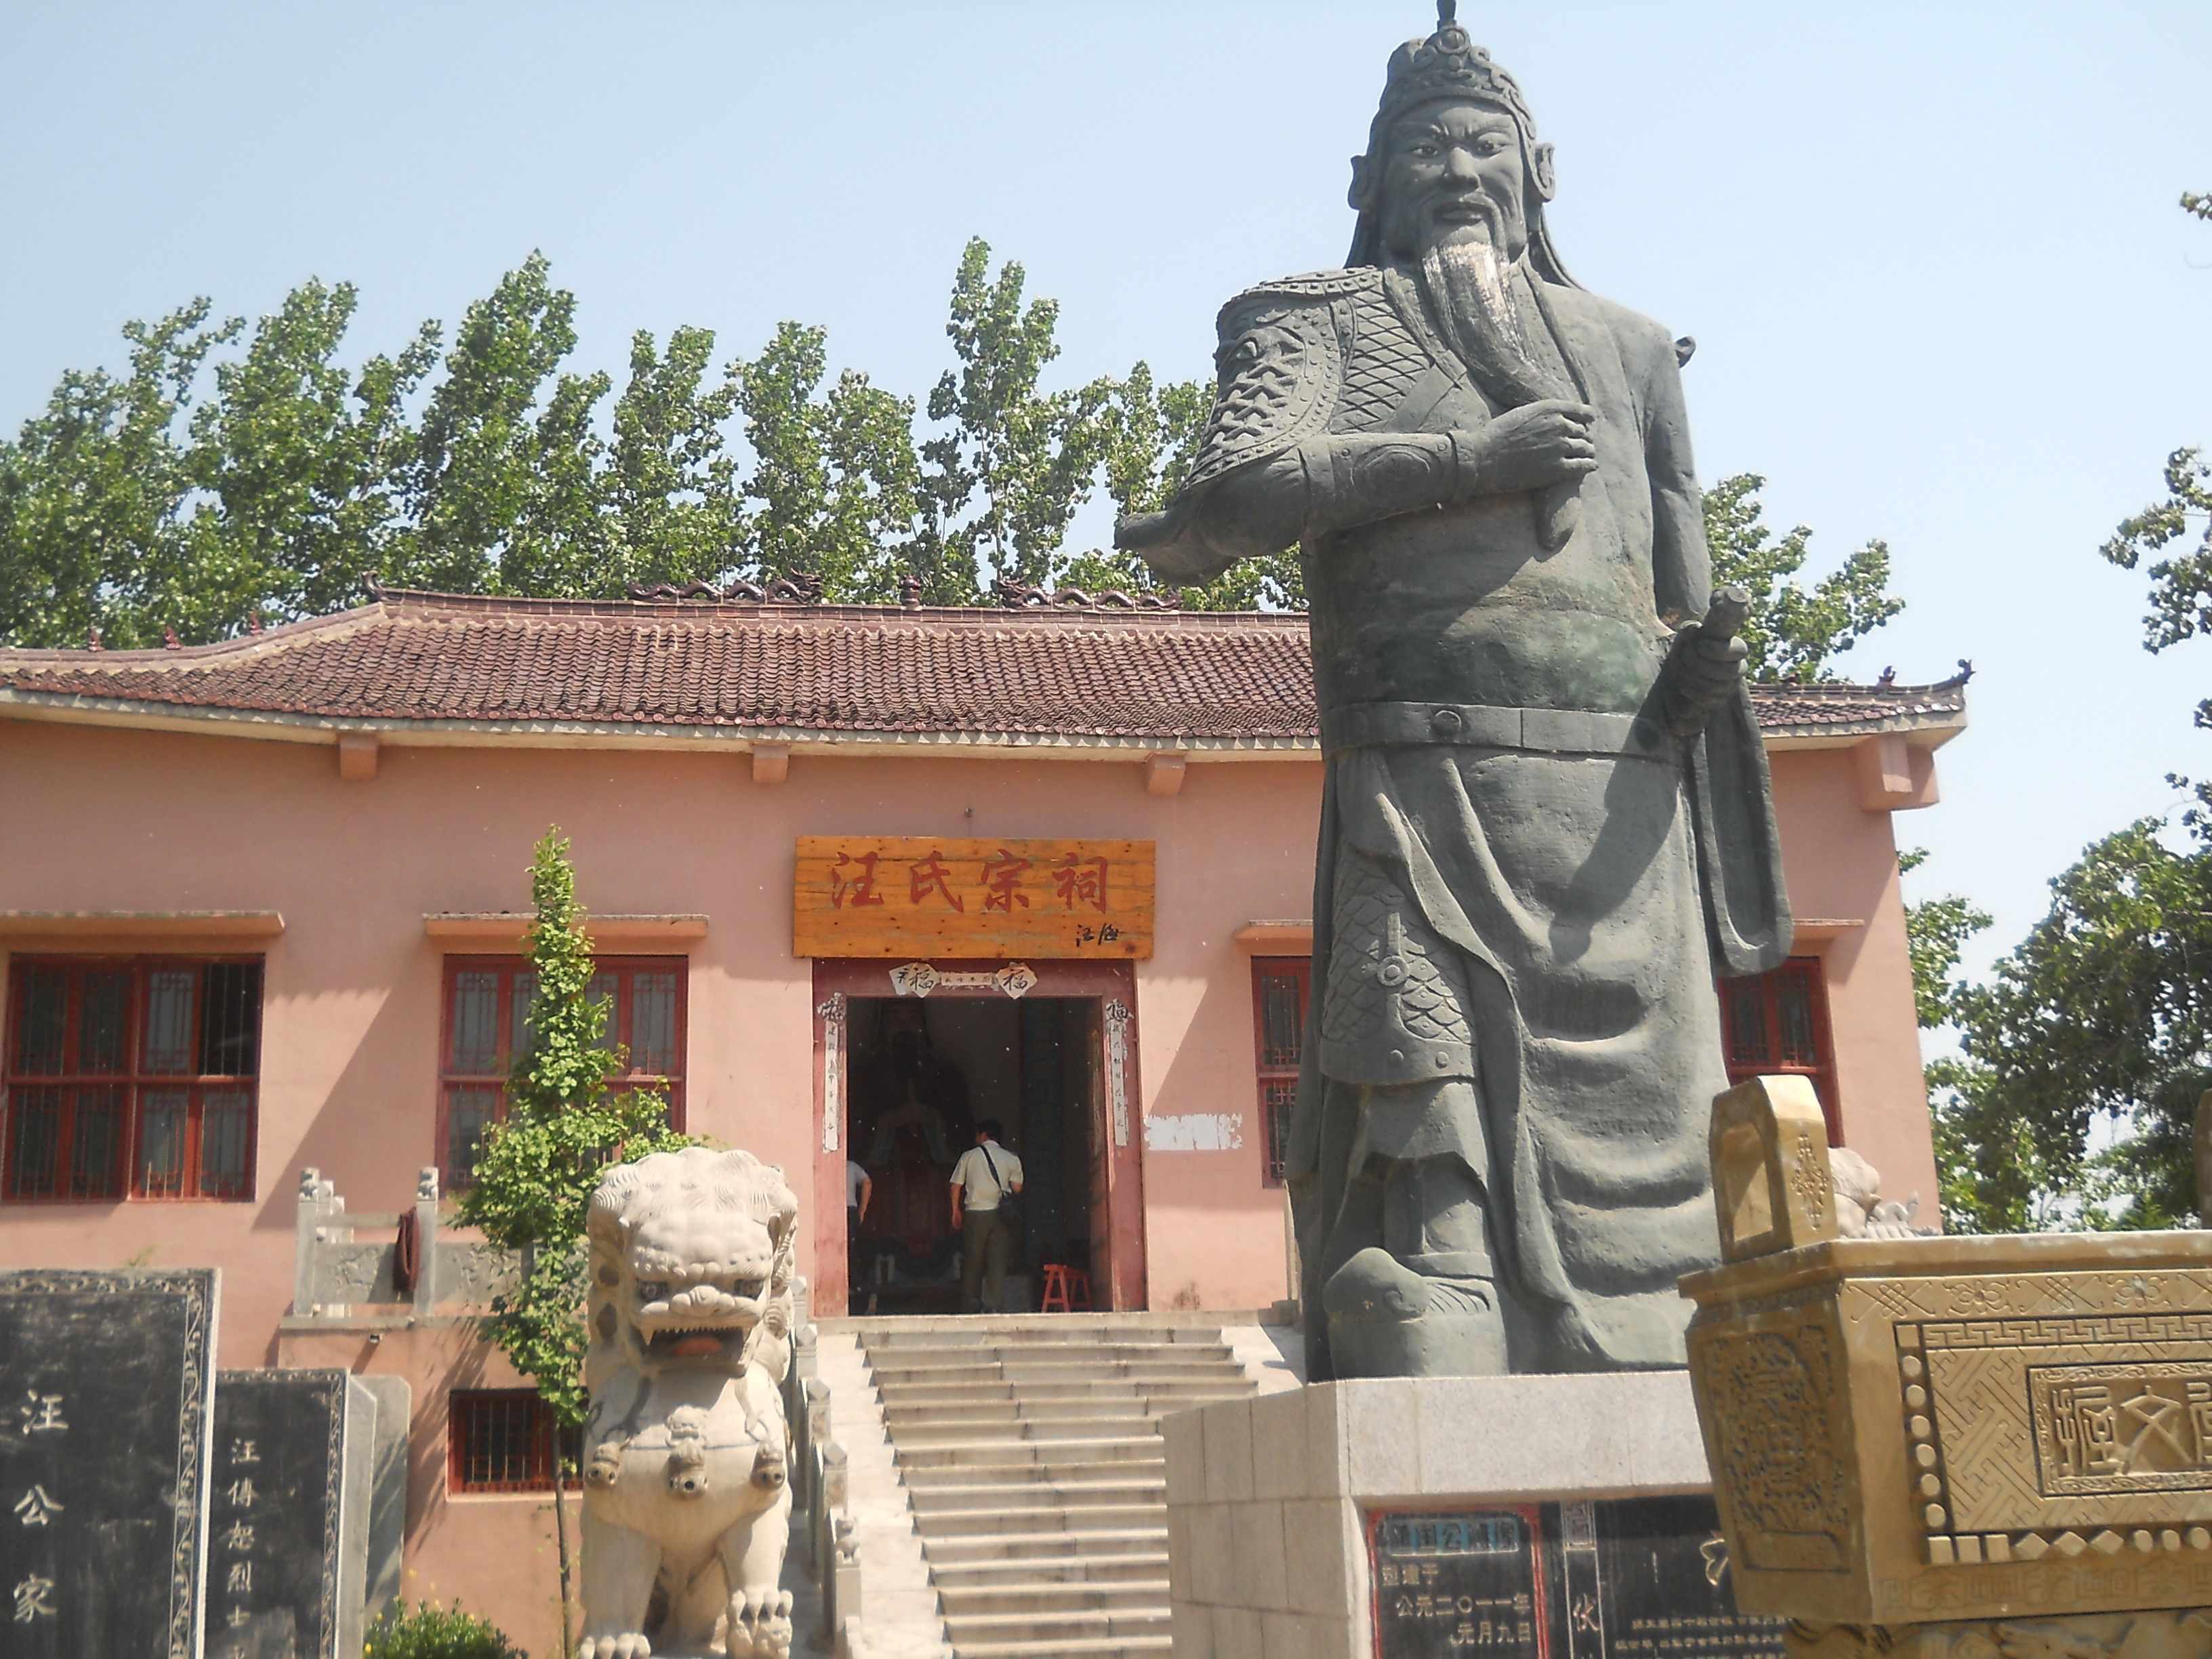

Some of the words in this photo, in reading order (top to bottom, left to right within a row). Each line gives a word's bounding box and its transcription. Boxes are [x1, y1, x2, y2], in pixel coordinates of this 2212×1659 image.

[831, 849, 1108, 914] 汪氏宗祠
[909, 968, 934, 990] 福
[1003, 969, 1028, 990] 福
[14, 1389, 68, 1622] 汪公家
[1456, 1620, 1531, 1645] 元月九日
